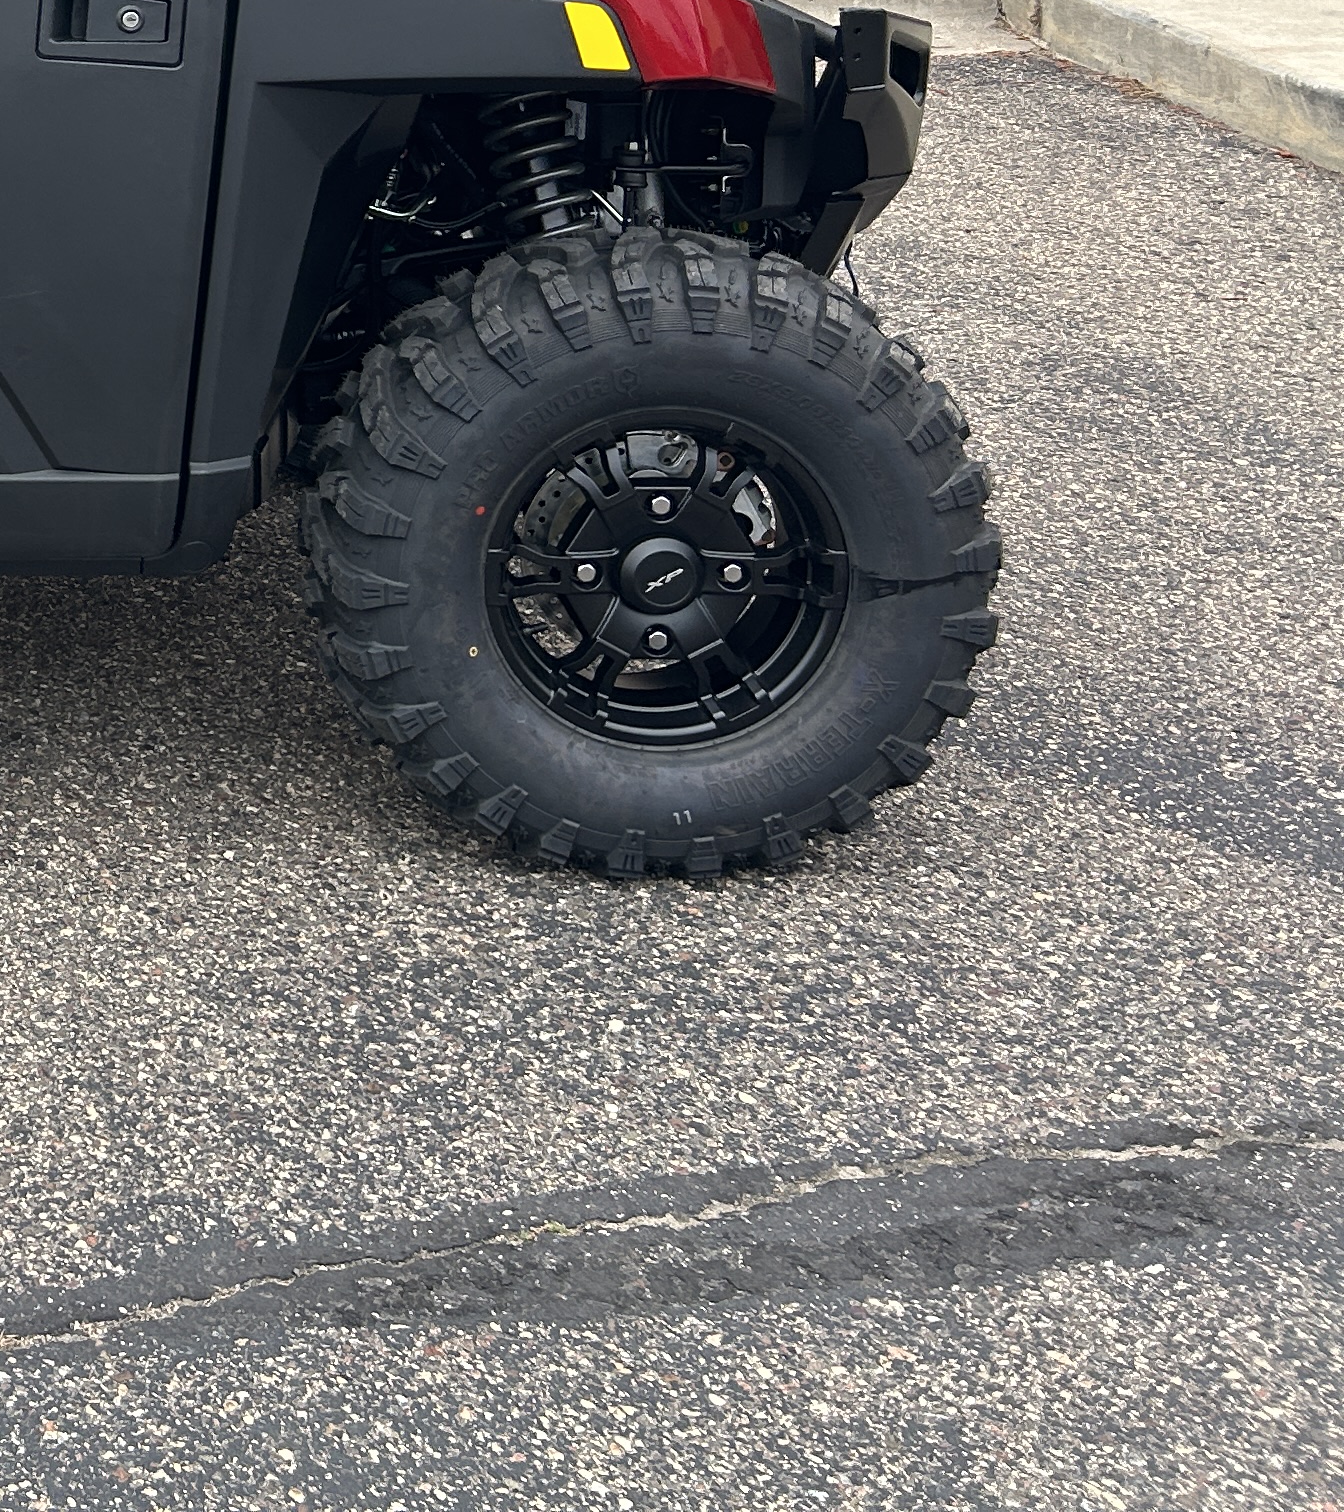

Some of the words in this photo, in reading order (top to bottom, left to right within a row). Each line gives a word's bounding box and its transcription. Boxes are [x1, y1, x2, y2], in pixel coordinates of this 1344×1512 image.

[455, 448, 500, 512] PRO
[499, 376, 611, 453] ARMOR
[644, 568, 684, 593] XP
[705, 667, 901, 812] X-TERRAIN
